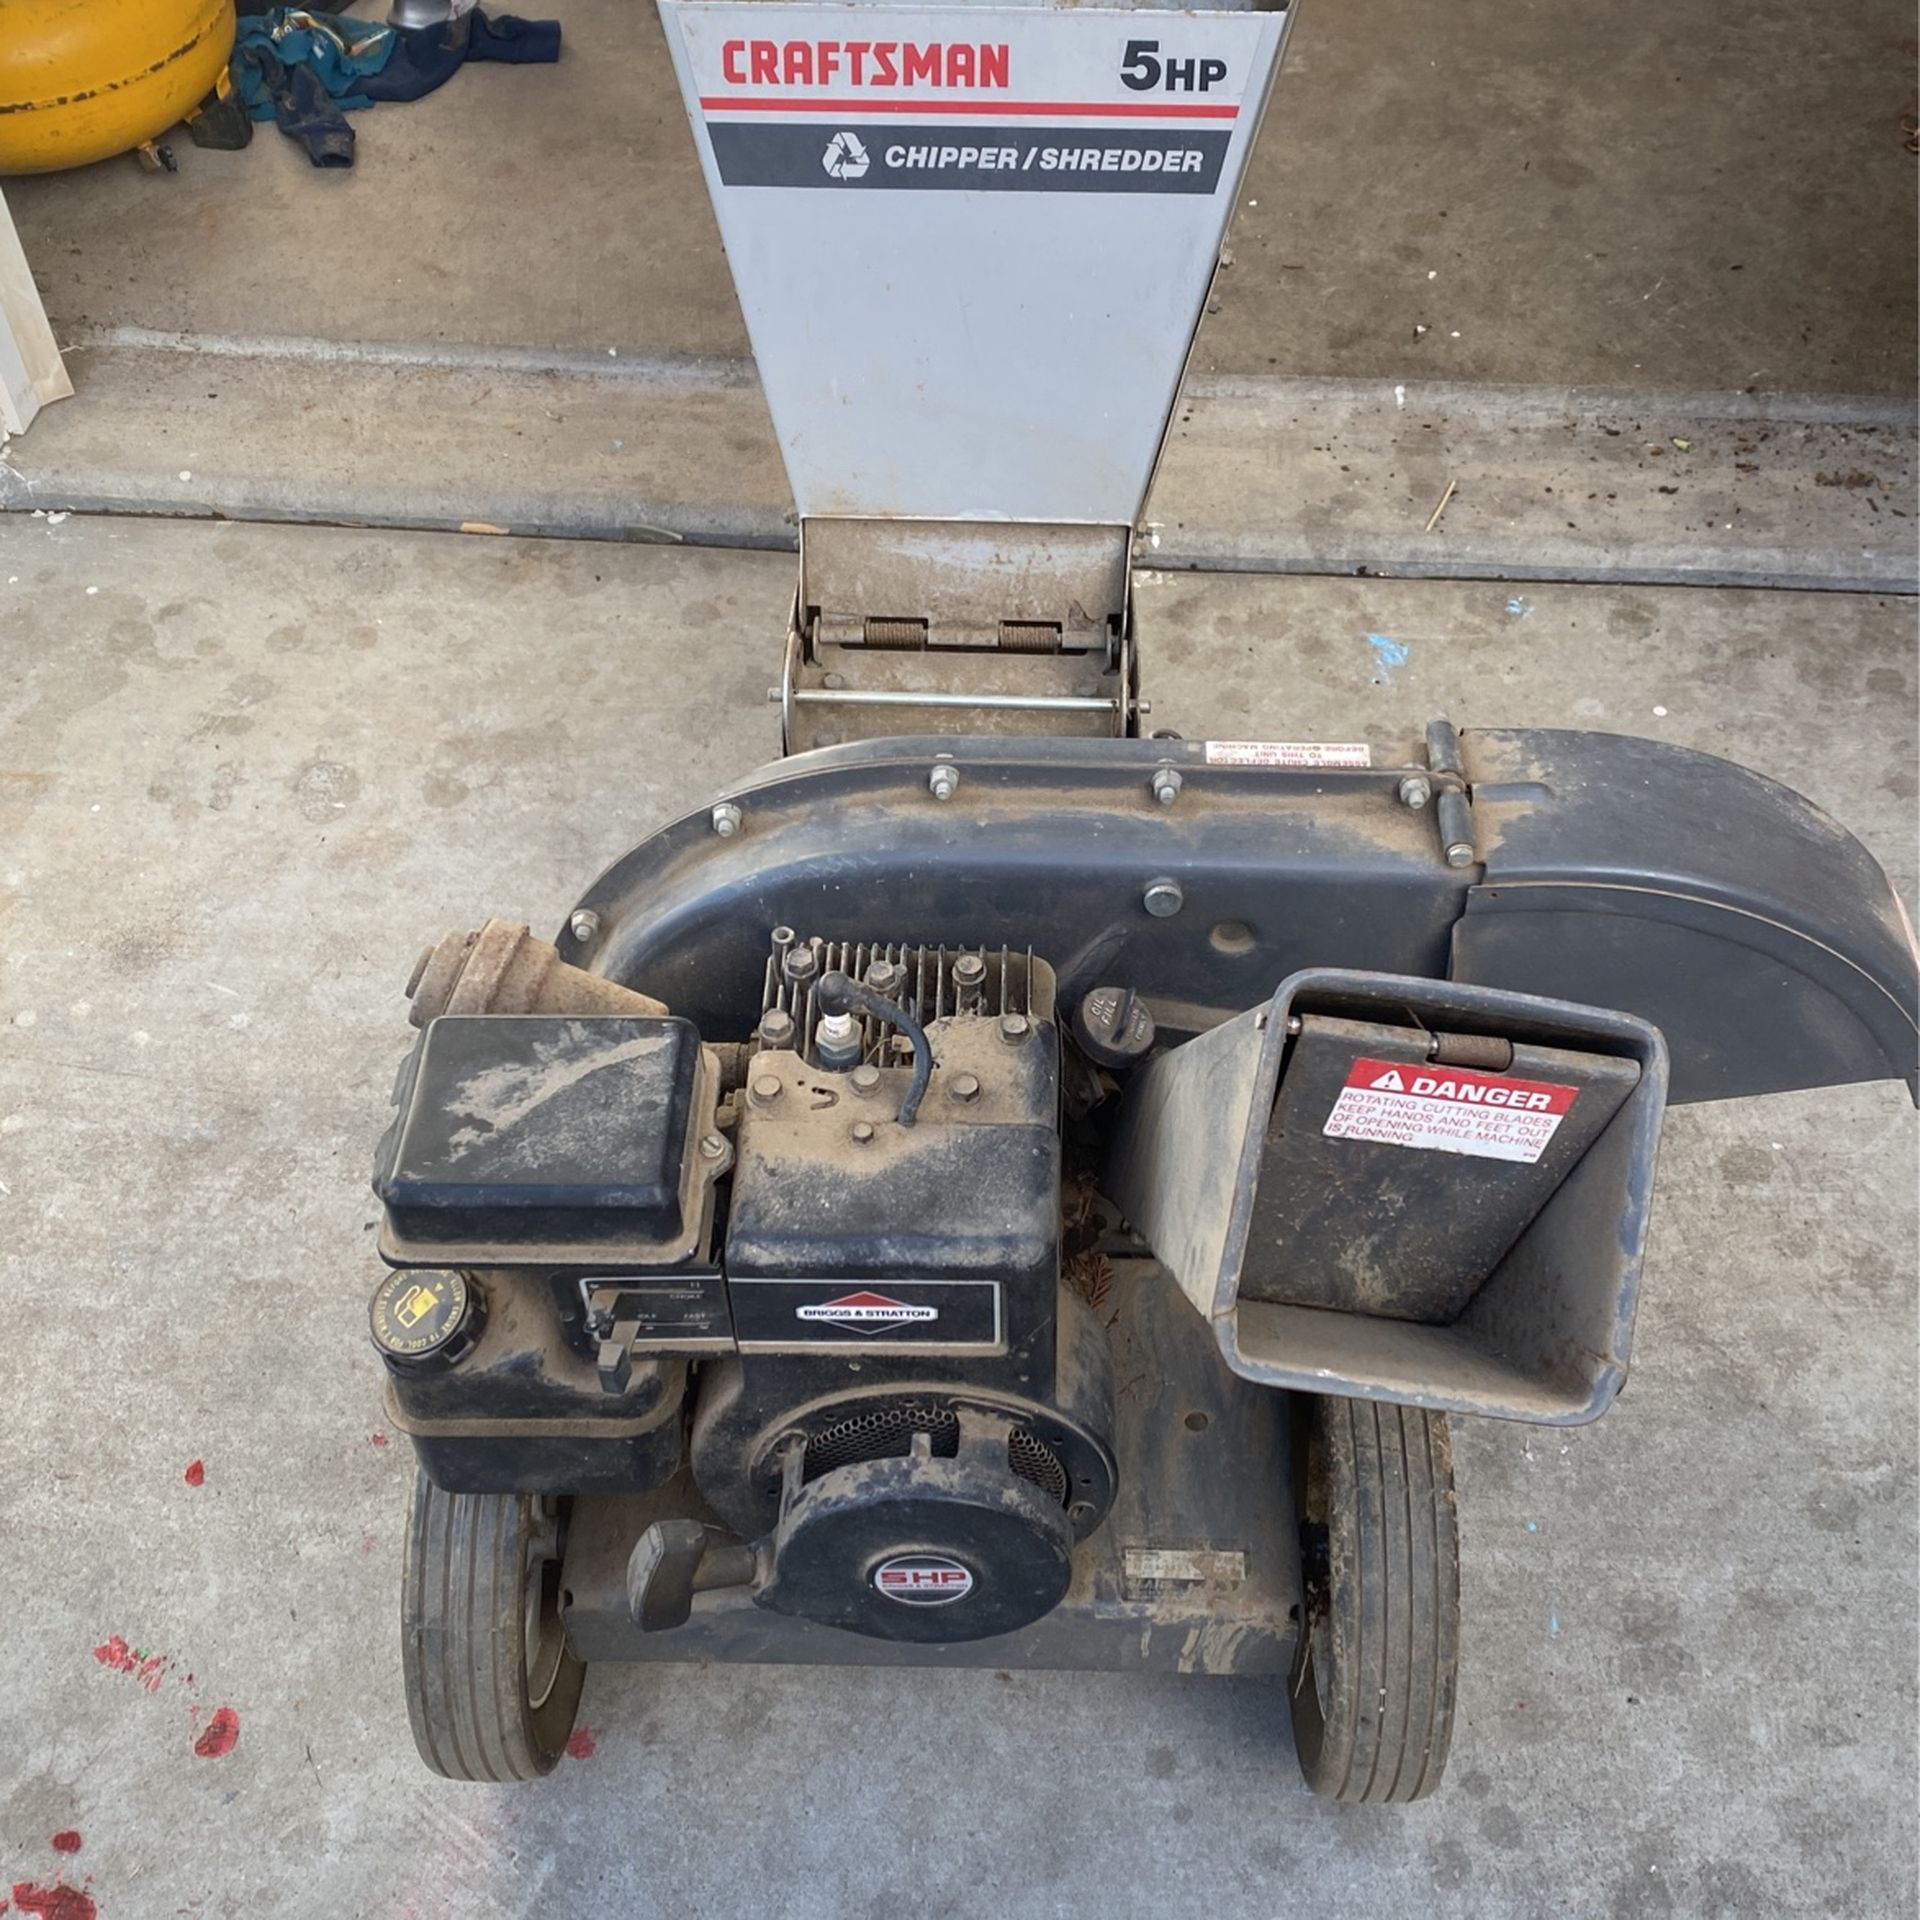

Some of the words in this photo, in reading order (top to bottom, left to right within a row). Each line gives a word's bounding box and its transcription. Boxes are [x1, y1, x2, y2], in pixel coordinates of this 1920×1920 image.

[722, 40, 1010, 88] CRAFTSMAN
[884, 144, 1204, 174] CHIPPER/SHREDDER
[1209, 757, 1271, 765] DEFLECTOR
[1280, 751, 1304, 759] THIS
[1091, 999, 1105, 1016] OIL
[1101, 1000, 1117, 1026] FILL
[1410, 1077, 1553, 1110] DANGER
[1337, 1103, 1377, 1114] KEEP
[1380, 1108, 1434, 1123] HANDS
[1438, 1116, 1472, 1128] AND
[1475, 1121, 1514, 1133] FEET
[1518, 1126, 1551, 1138] OUT
[1342, 1092, 1418, 1110] ROTATING
[1422, 1102, 1490, 1120] CUTTING
[1494, 1112, 1553, 1128] BLADES
[1327, 1123, 1341, 1132] IS
[1344, 1125, 1414, 1142] RUNNING
[1332, 1113, 1353, 1122] OF
[1356, 1116, 1424, 1133] OPENING
[1427, 1125, 1475, 1139] WHILE
[1476, 1132, 1547, 1149] MACHINE
[803, 1309, 852, 1318] BRIGGS
[854, 1309, 863, 1317] &
[865, 1309, 931, 1318] STRATTON
